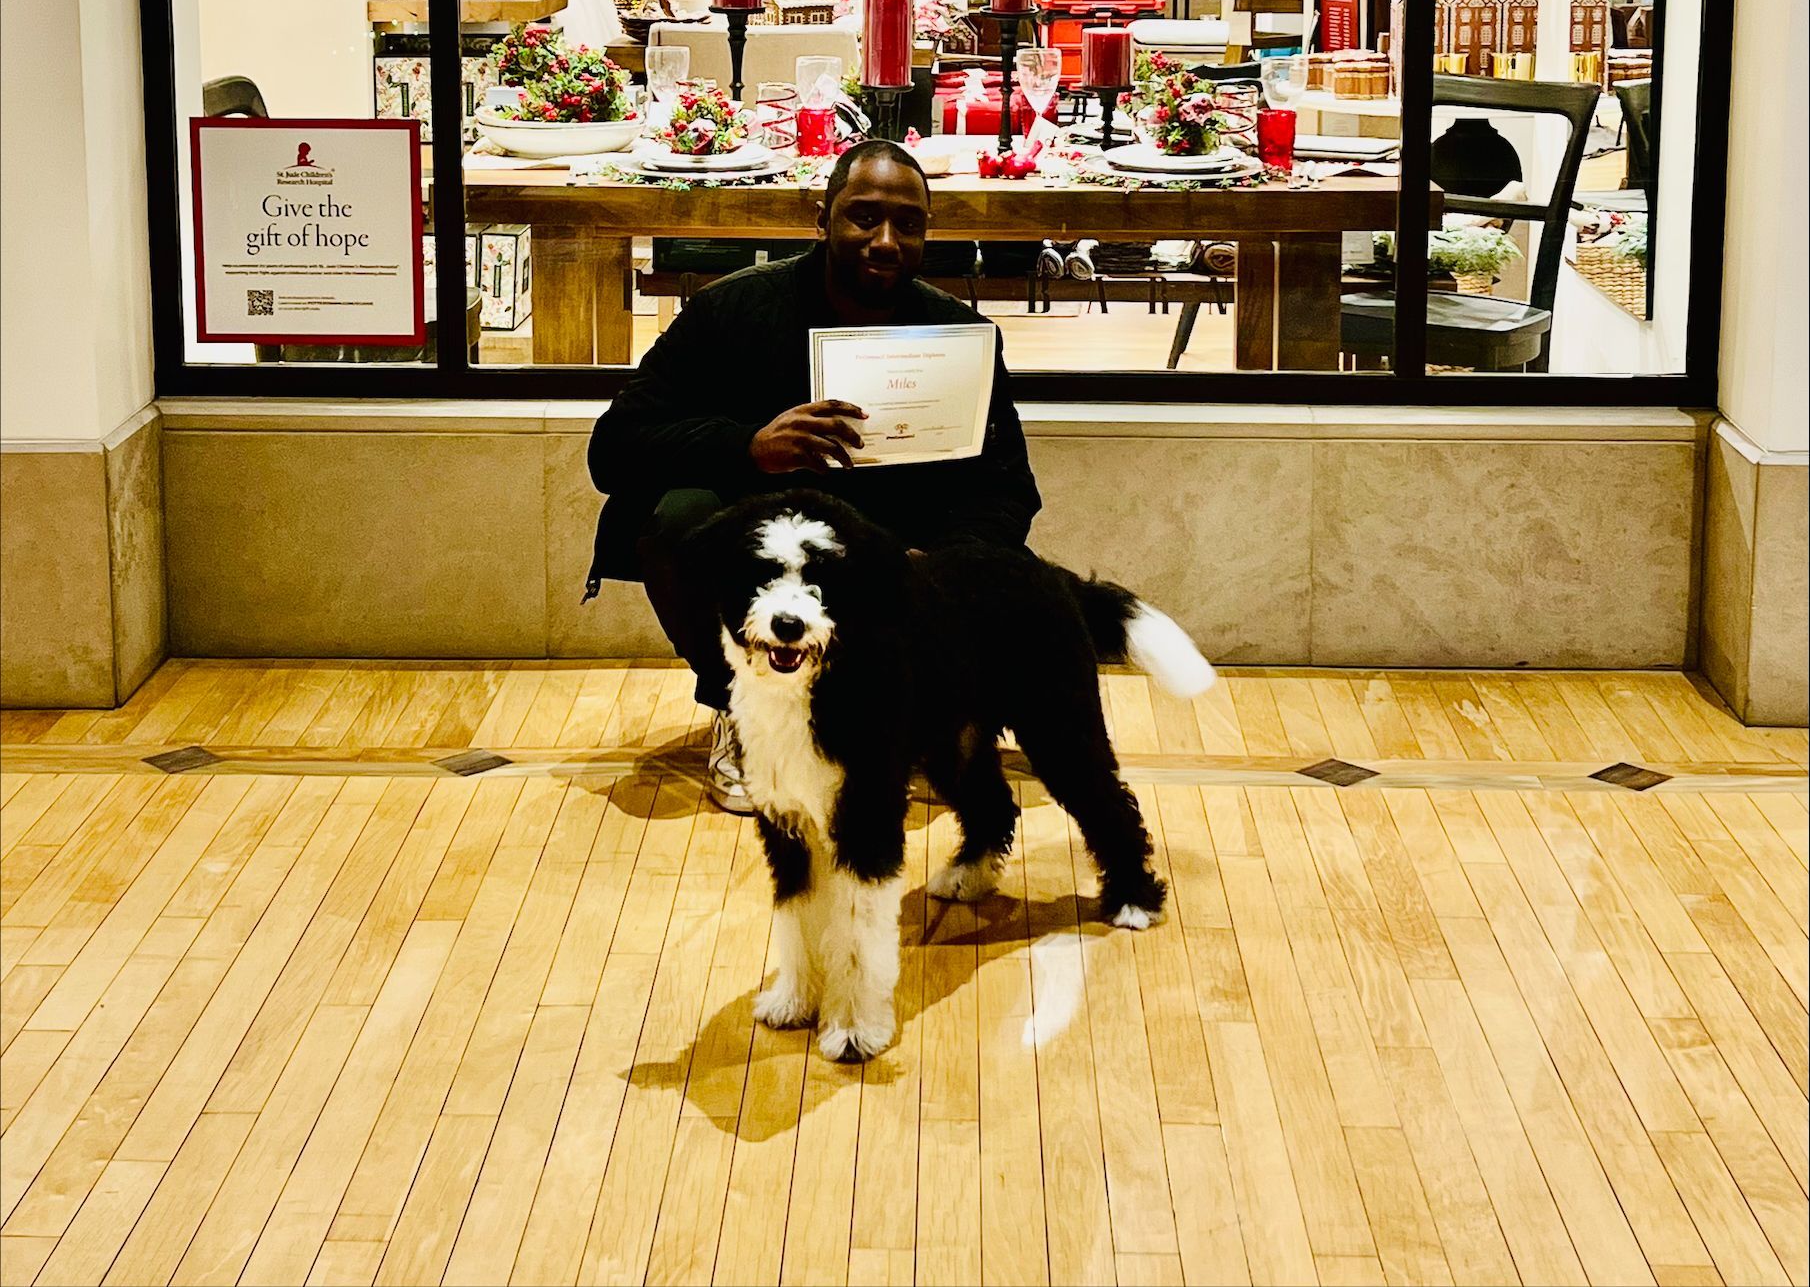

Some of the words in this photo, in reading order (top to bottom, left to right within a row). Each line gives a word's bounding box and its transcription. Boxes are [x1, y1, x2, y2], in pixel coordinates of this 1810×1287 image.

[306, 178, 333, 186] Hospital
[262, 194, 313, 218] Give
[318, 194, 353, 218] the
[246, 223, 282, 256] gift
[287, 223, 312, 247] of
[315, 224, 369, 256] hope
[887, 377, 917, 390] Miles
